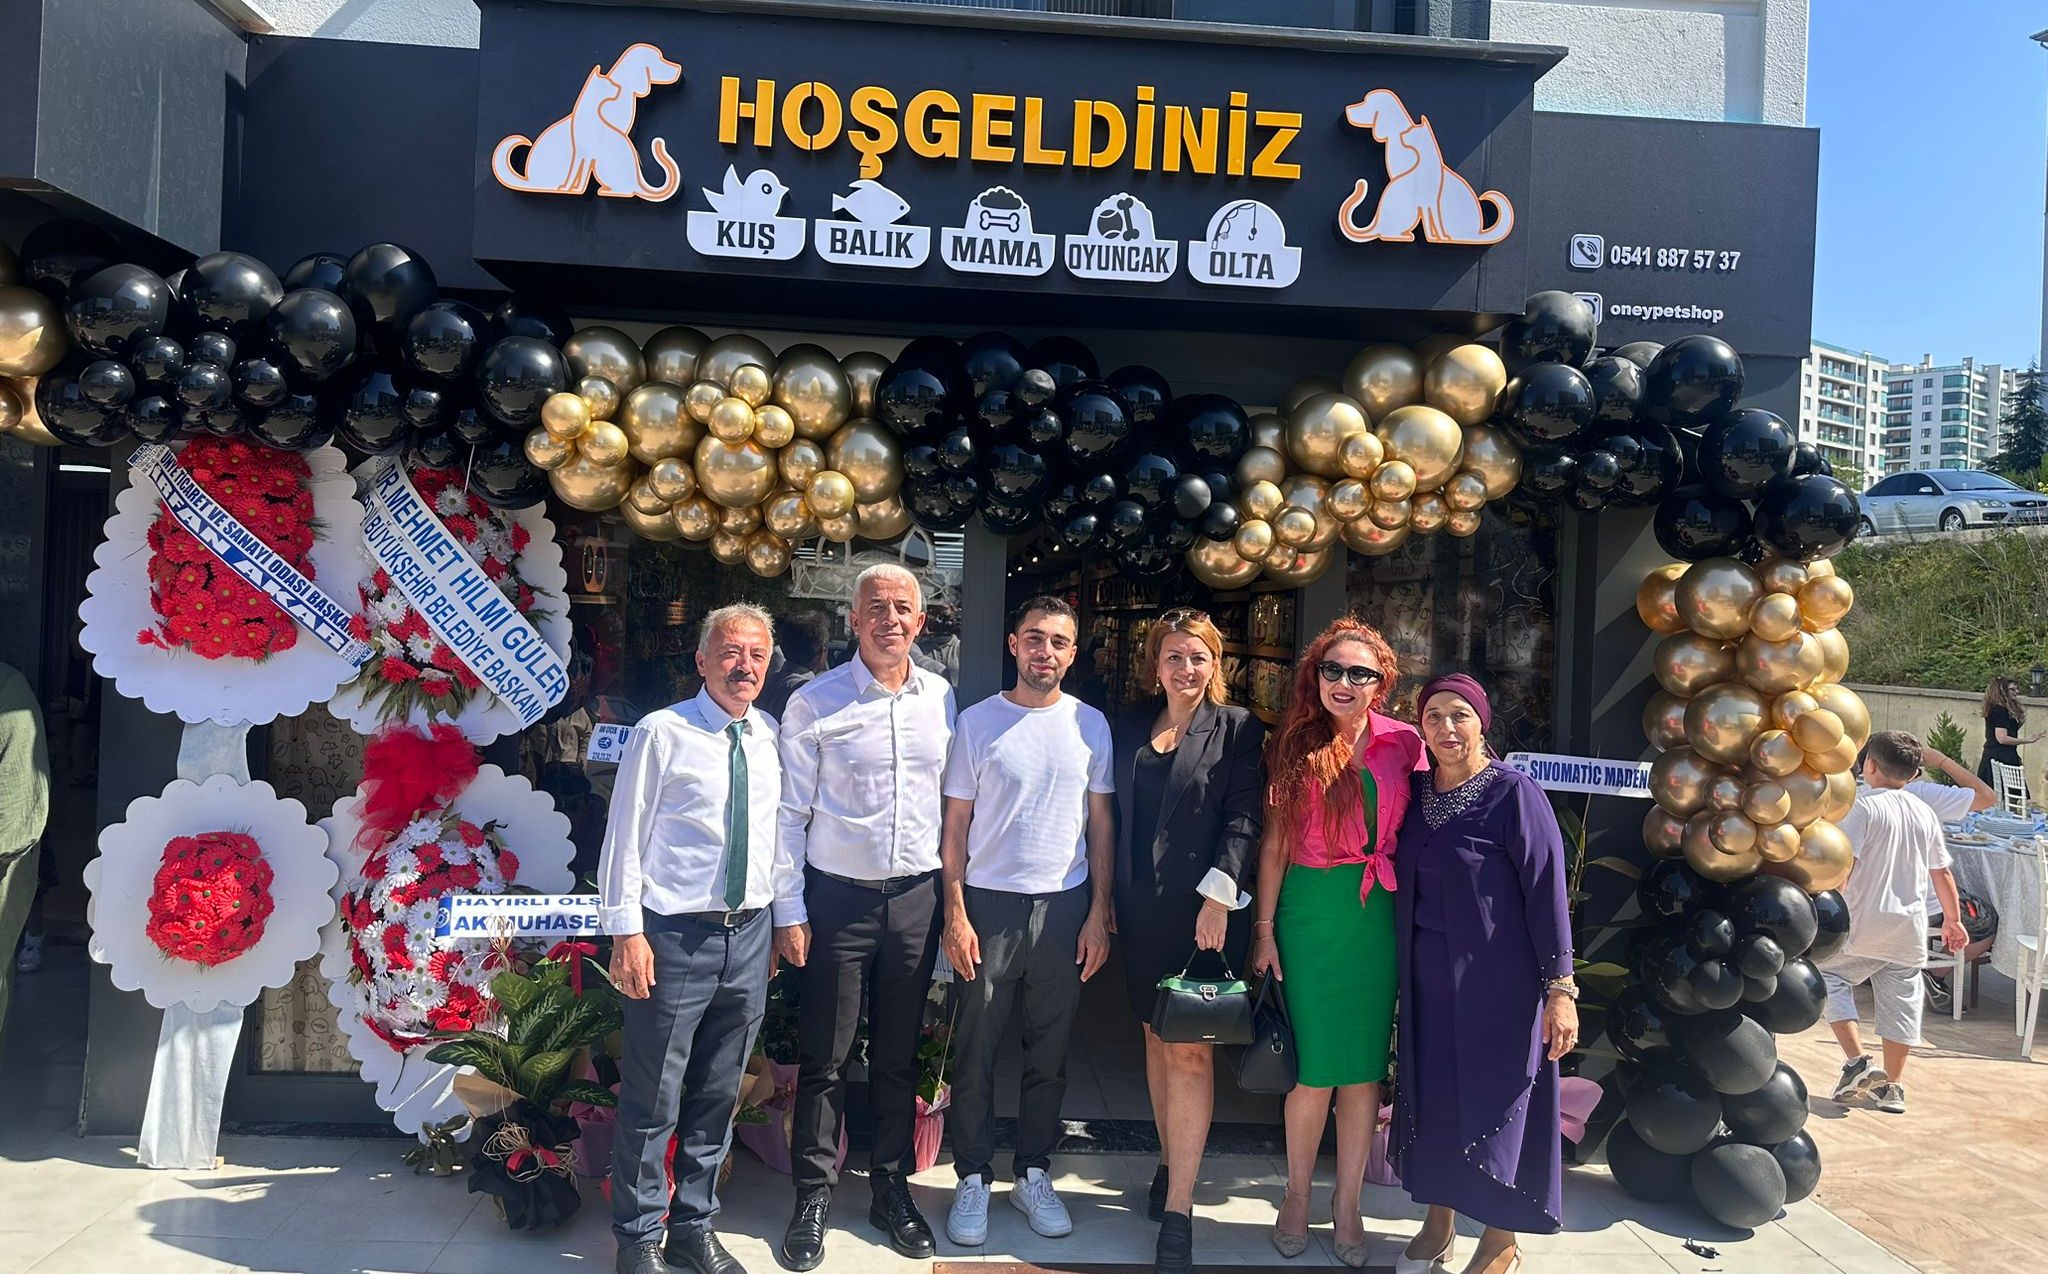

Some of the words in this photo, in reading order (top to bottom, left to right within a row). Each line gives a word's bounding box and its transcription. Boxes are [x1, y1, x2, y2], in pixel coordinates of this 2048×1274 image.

[717, 75, 1303, 180] HOŞGELDİNİZ
[715, 220, 775, 255] KUŞ
[829, 227, 914, 259] BALIK
[950, 235, 1045, 269] MAMA
[1067, 243, 1171, 274] OYUNCAK
[1209, 251, 1275, 280] OLTA
[1610, 245, 1651, 266] 0541
[1656, 248, 1689, 268] 887
[1693, 250, 1715, 269] 57
[1718, 251, 1741, 270] 37
[1610, 303, 1724, 323] oneypetshop
[207, 506, 229, 527] VE
[223, 520, 274, 564] SANAYİ
[268, 559, 310, 599] ODASI
[233, 560, 349, 651] AKAR
[364, 514, 437, 604] BÜYÜKŞEHİR
[424, 594, 494, 667] BELEDİYE
[482, 658, 543, 723] BAŞKANI
[449, 567, 519, 633] HİLMİ
[502, 626, 566, 702] GÜLER
[1530, 760, 1602, 786] SIVOMATİC
[1604, 766, 1651, 789] MADEN
[456, 897, 550, 906] HAYIRLI
[454, 915, 488, 930] AK
